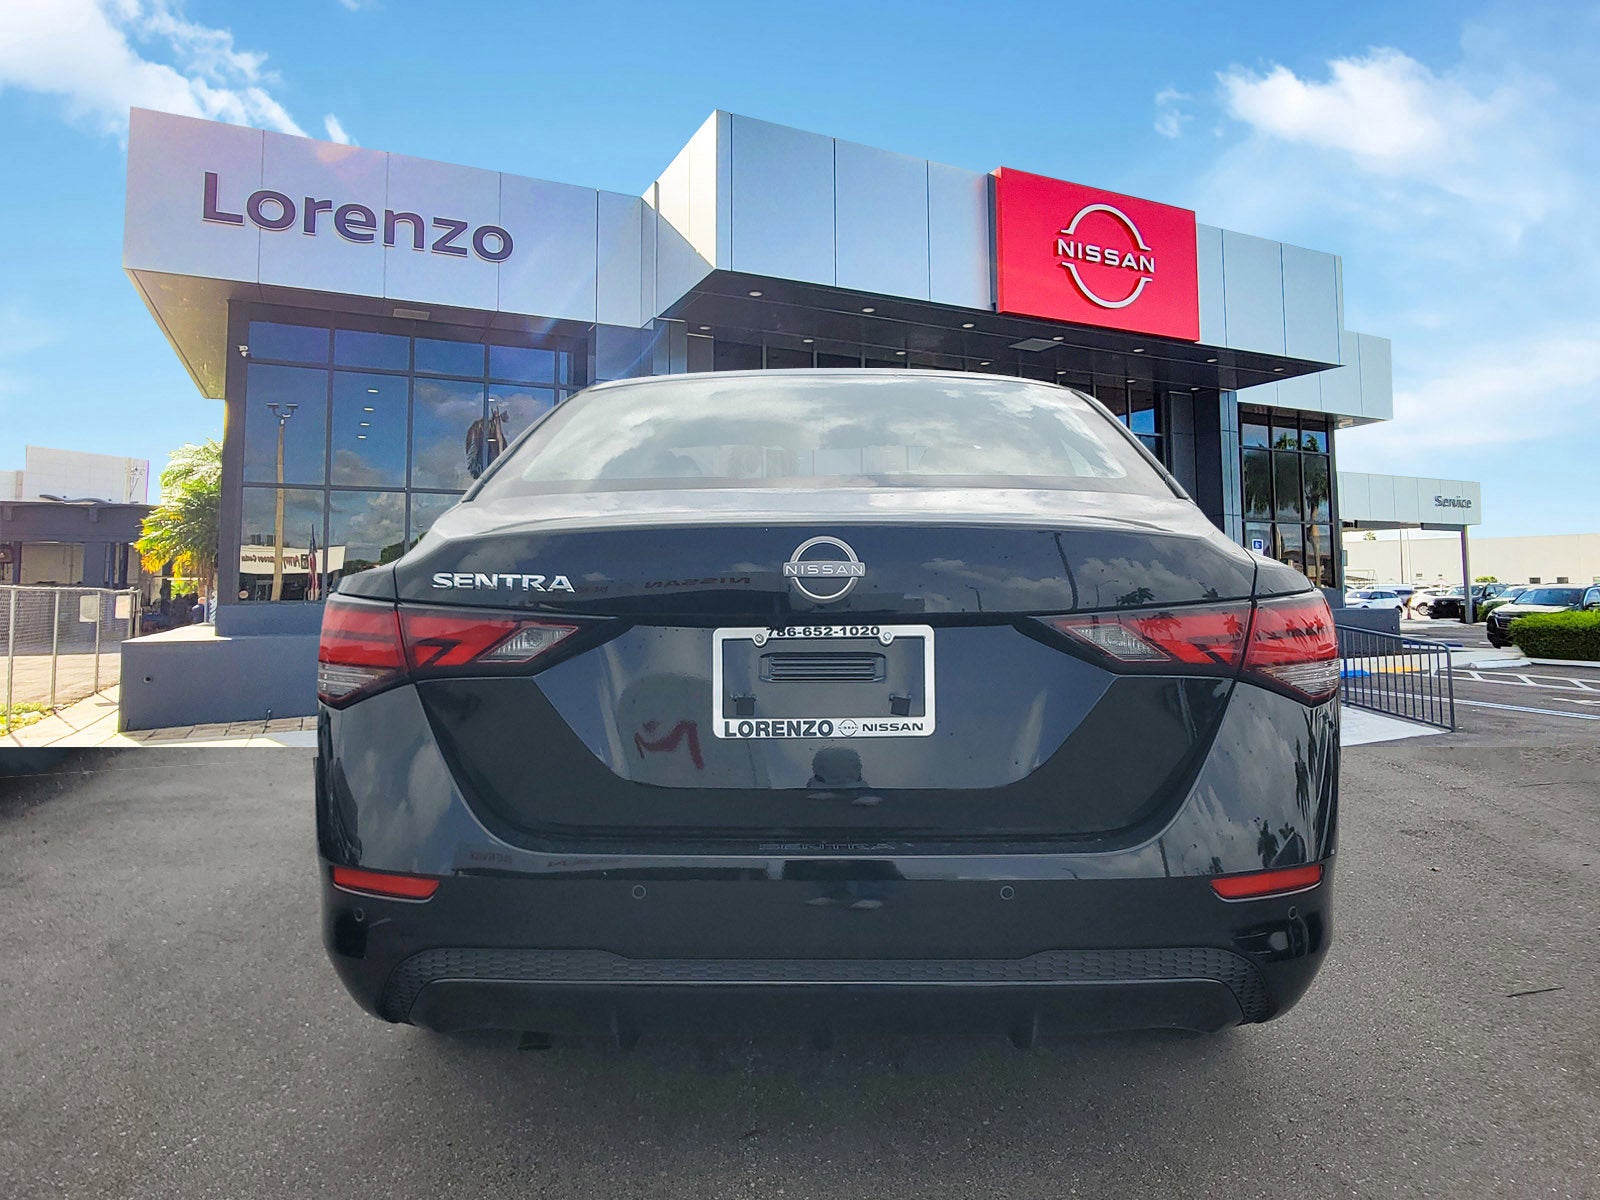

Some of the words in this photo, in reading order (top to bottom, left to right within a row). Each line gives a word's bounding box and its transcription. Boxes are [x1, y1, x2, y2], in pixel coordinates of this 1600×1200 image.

[202, 171, 514, 263] Lorenzo
[1057, 238, 1155, 273] NISSAN
[1434, 495, 1472, 508] Service
[785, 563, 863, 576] NISSAN
[432, 572, 576, 593] SENTRA
[766, 626, 880, 637] 786-652-1020
[724, 720, 834, 737] LORENZO
[862, 723, 924, 731] NISSAN
